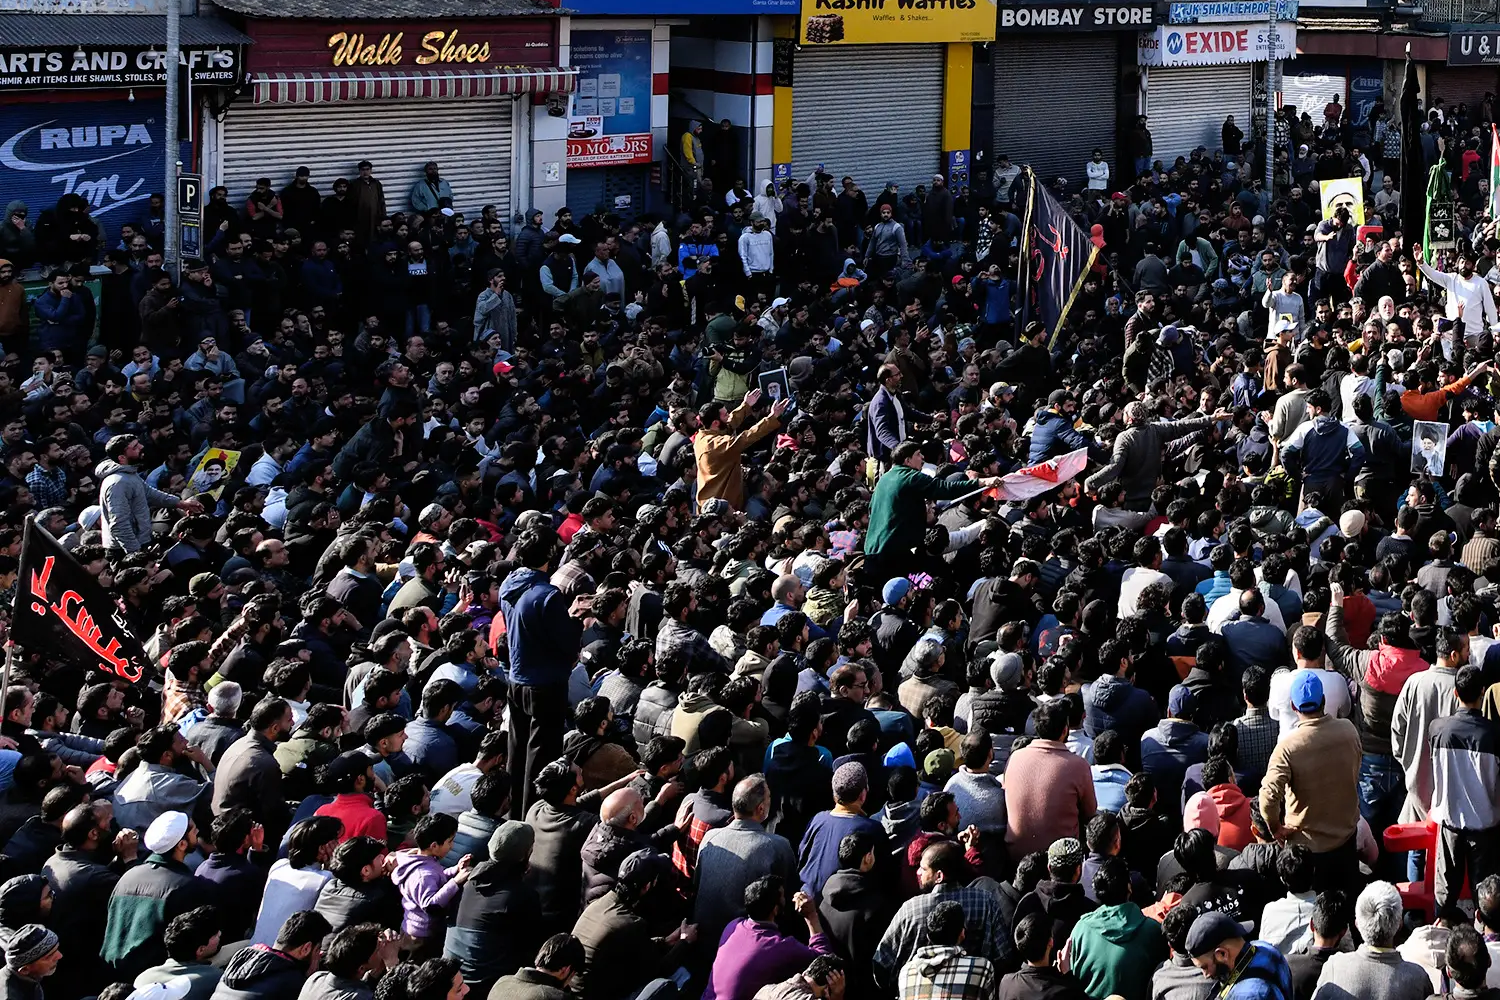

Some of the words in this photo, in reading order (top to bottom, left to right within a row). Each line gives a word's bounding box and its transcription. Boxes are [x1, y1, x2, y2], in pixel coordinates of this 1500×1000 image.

[872, 14, 896, 22] Waffles
[900, 14, 905, 22] &
[1002, 8, 1084, 27] BOMBAY
[1094, 7, 1153, 25] STORE
[1185, 2, 1199, 16] JK
[1202, 2, 1234, 15] SHAWL
[1236, 0, 1286, 14] EMPORM
[328, 31, 404, 67] Walk
[416, 29, 491, 65] Shoes
[1185, 30, 1249, 54] EXIDE
[1461, 36, 1473, 56] U
[1478, 35, 1491, 56] &
[71, 52, 127, 71] AND
[136, 50, 234, 70] CRAFTS
[0, 77, 22, 85] HMIR
[24, 76, 41, 84] ART
[43, 75, 68, 84] ITEMS
[70, 75, 87, 83] LIKE
[89, 74, 122, 83] SHAWLS,
[125, 73, 155, 83] STOLES,
[195, 71, 233, 80] SWEATERS
[40, 124, 153, 150] RUPA
[586, 140, 649, 155] MOORS
[186, 184, 196, 203] P
